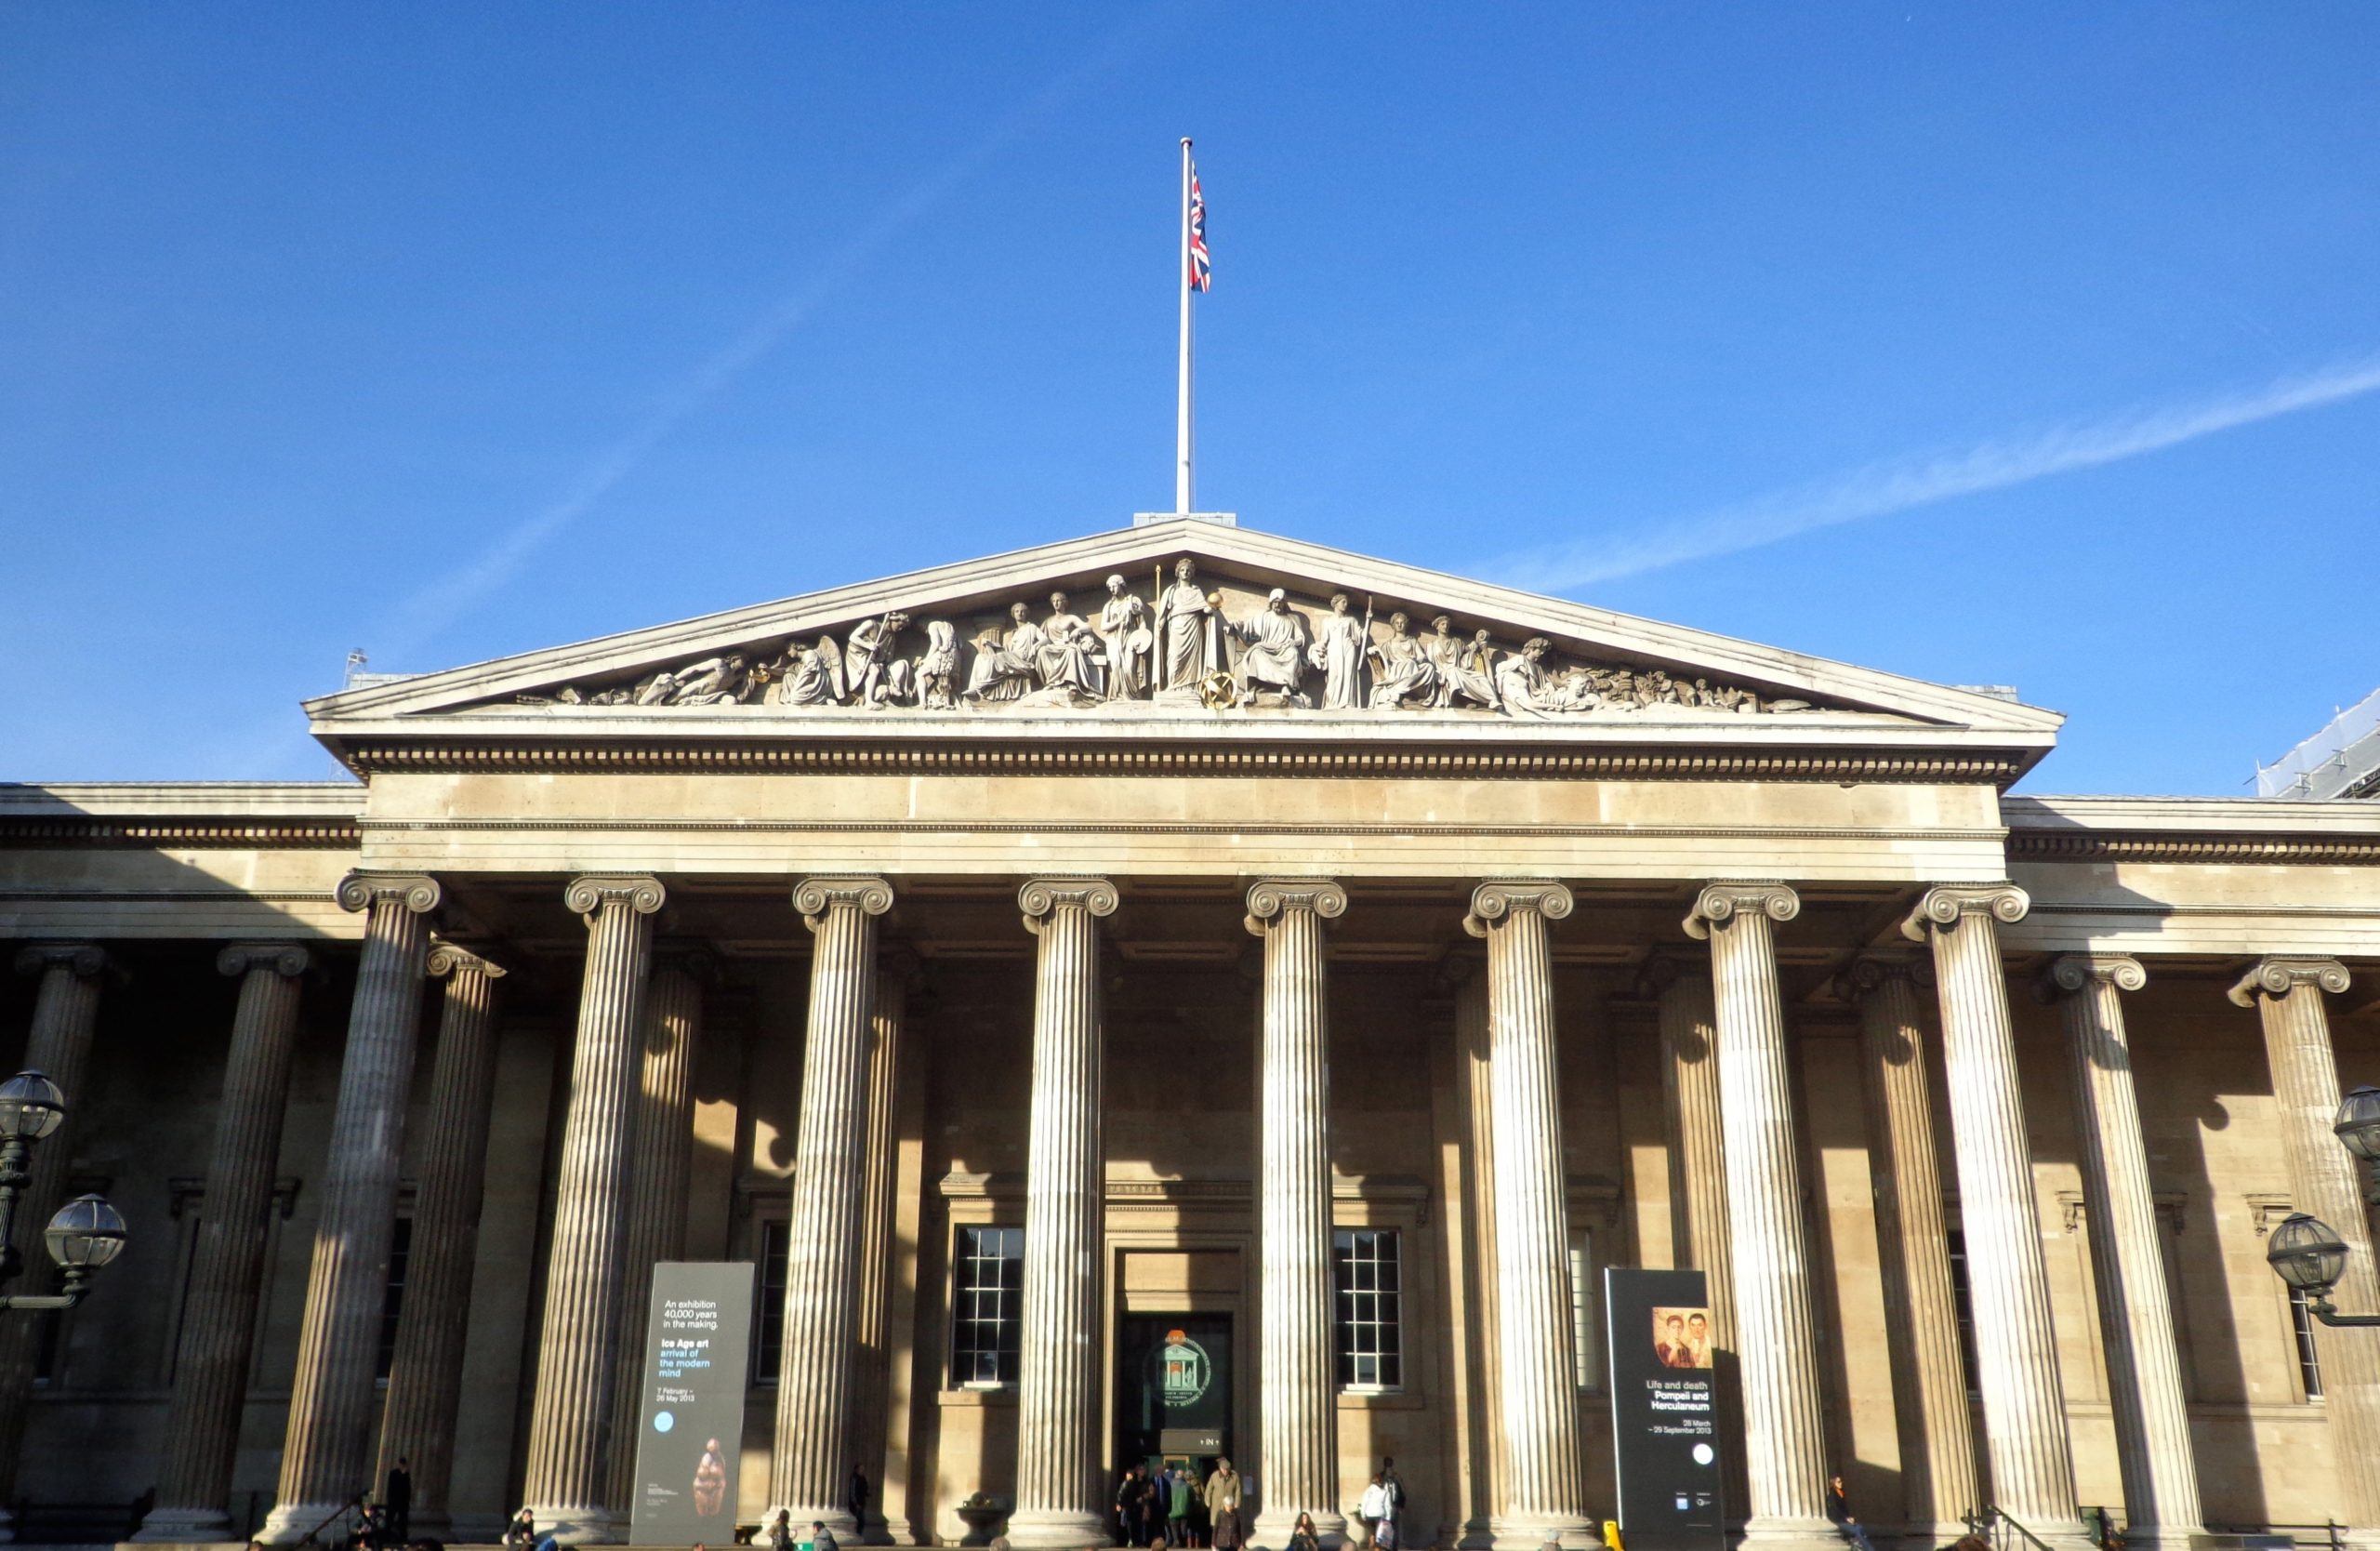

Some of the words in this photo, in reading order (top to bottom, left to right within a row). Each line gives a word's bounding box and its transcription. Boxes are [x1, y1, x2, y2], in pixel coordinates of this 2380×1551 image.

[665, 1300, 677, 1308] An
[679, 1300, 716, 1308] exhibition
[665, 1309, 694, 1319] 40,000
[695, 1311, 718, 1320] years
[663, 1319, 670, 1328] in
[673, 1319, 685, 1328] the
[688, 1319, 719, 1331] making.
[661, 1339, 675, 1347] Ice
[677, 1339, 694, 1349] Age
[696, 1339, 709, 1348] art
[660, 1349, 687, 1358] arrival
[689, 1349, 699, 1358] of
[659, 1359, 674, 1368] the
[676, 1359, 710, 1368] modern
[658, 1369, 681, 1377] mind
[1646, 1380, 1662, 1389] Life
[1664, 1381, 1681, 1389] and
[1683, 1382, 1708, 1390] death
[663, 1387, 688, 1396] February
[1655, 1390, 1690, 1401] Pompeii
[1692, 1392, 1709, 1400] and
[666, 1395, 679, 1403] May
[1651, 1401, 1710, 1412] Herculaneum
[1664, 1426, 1695, 1435] September
